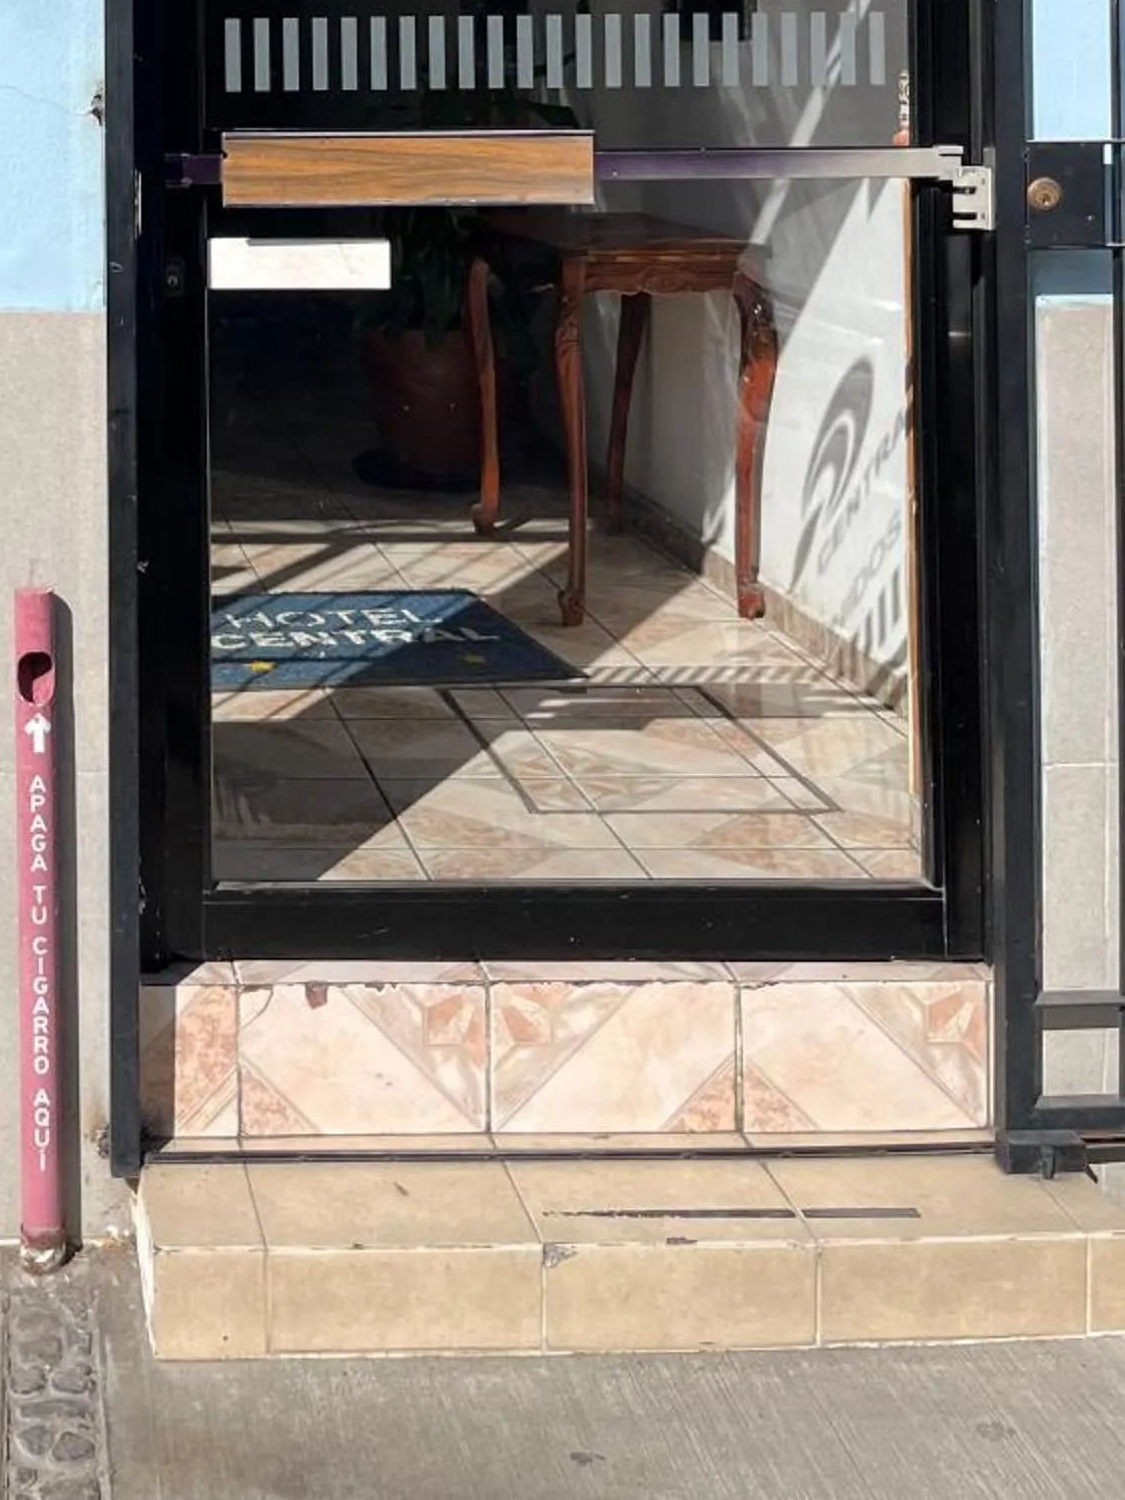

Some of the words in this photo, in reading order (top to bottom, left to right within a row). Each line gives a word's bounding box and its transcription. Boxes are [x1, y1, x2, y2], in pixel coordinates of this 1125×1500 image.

[227, 607, 443, 628] HOTEL
[211, 628, 500, 648] CENTRAL
[30, 775, 47, 871] APAGA
[31, 886, 47, 924] TU
[32, 937, 49, 1074] CIGARRO
